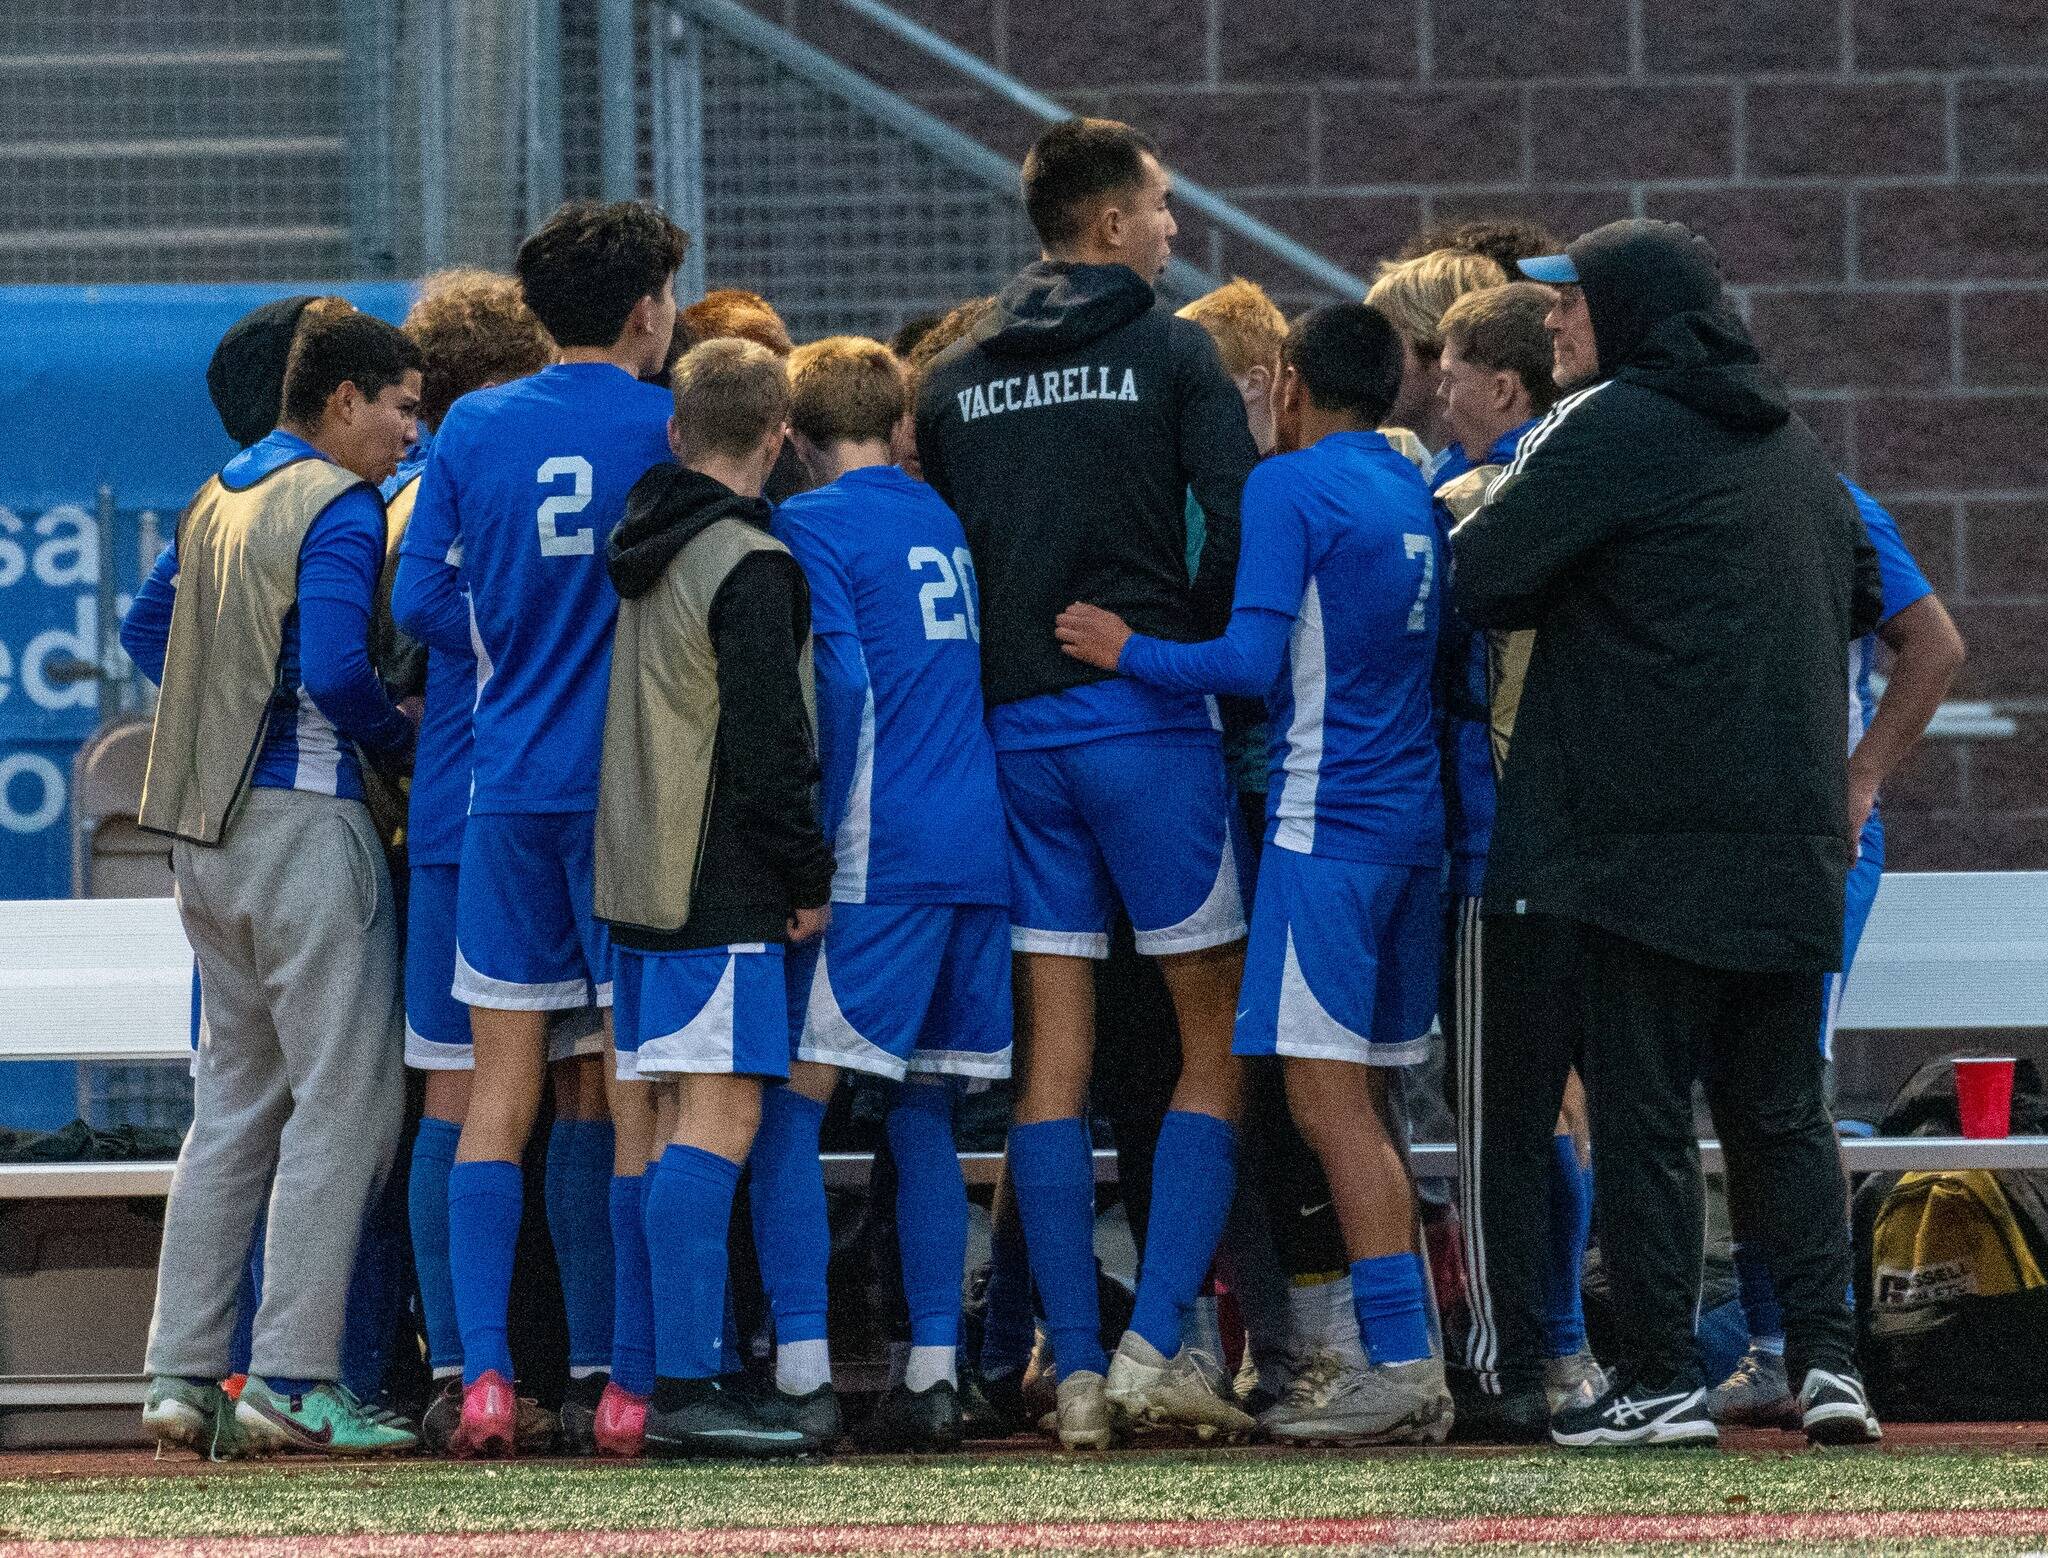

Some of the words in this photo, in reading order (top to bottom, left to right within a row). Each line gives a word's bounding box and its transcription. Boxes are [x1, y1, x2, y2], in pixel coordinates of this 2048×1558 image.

[957, 366, 1139, 422] VACCARELLA
[536, 455, 595, 557] 2
[1403, 532, 1434, 631] 7
